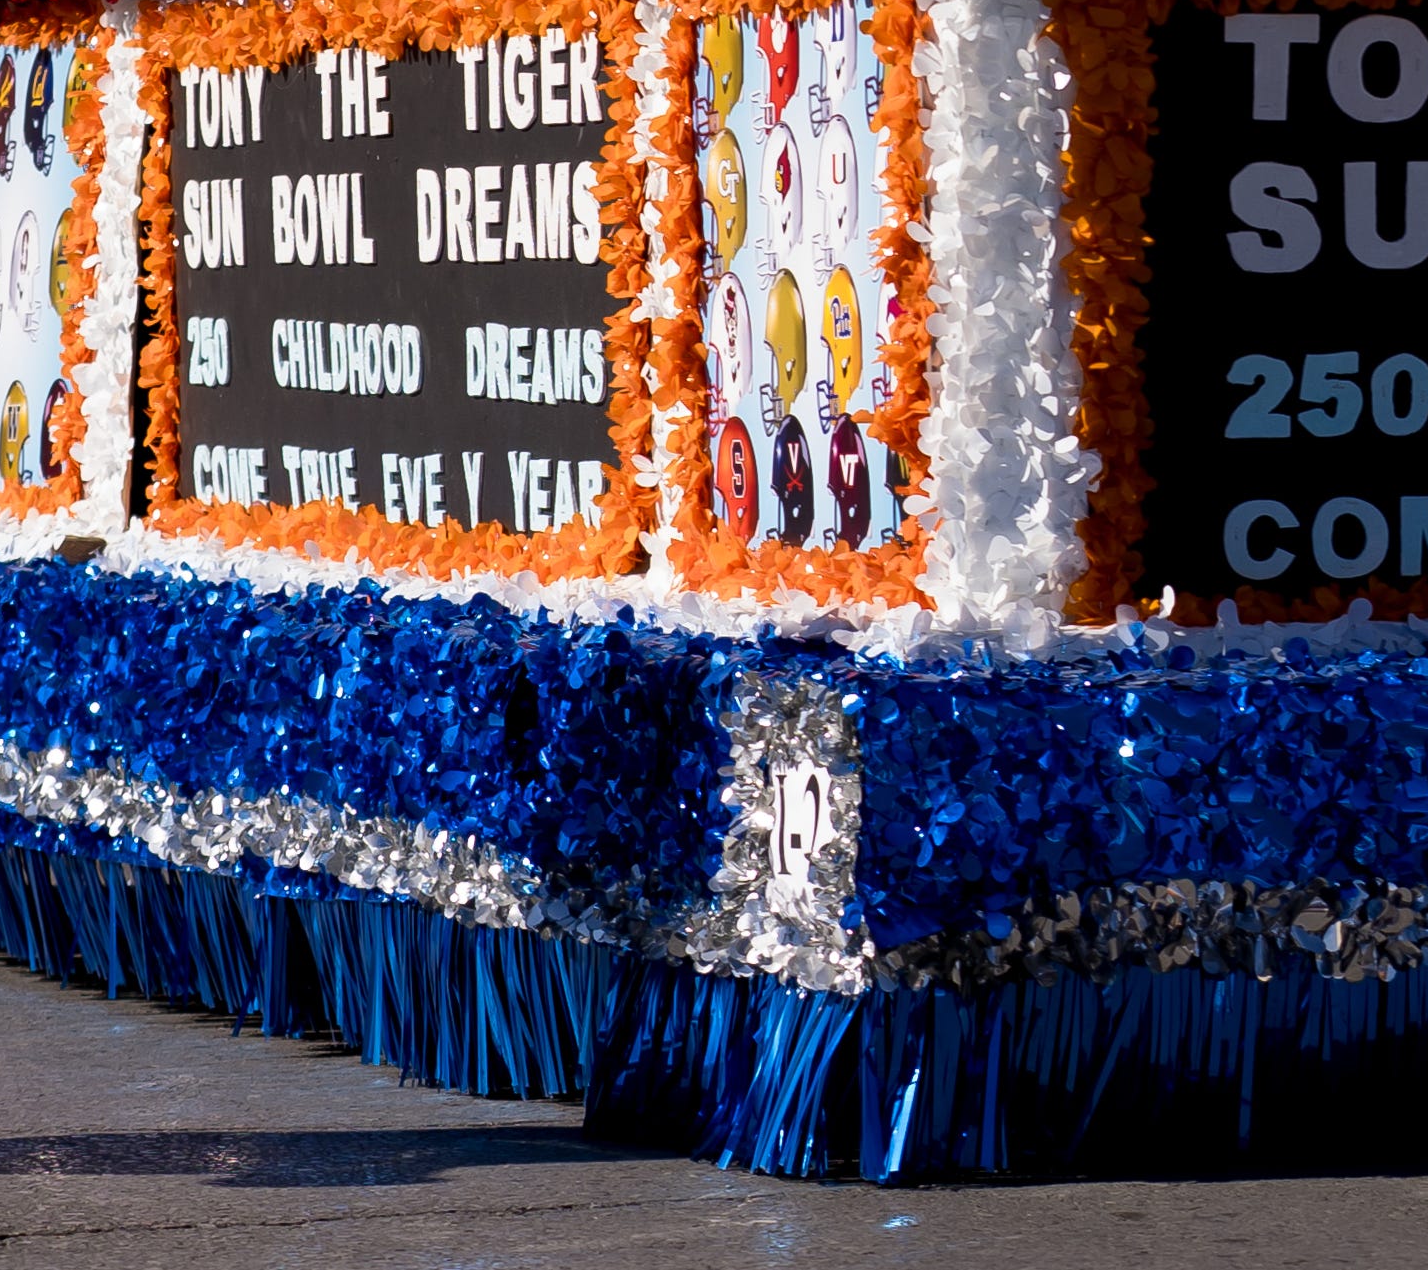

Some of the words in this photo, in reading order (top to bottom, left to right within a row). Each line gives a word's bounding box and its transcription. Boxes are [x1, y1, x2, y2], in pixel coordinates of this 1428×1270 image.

[180, 63, 267, 149] TONY
[315, 46, 392, 141] THE
[457, 27, 603, 131] TIGER
[717, 158, 740, 207] GT
[831, 152, 847, 186] U
[183, 178, 244, 269] SUN
[272, 172, 376, 266] BOWL
[416, 161, 602, 265] DREAMS
[187, 316, 230, 387] 250
[273, 318, 422, 397] CHILDHOOD
[466, 322, 606, 405] DREAMS
[193, 444, 270, 511] COME
[282, 445, 361, 515] TRUE
[508, 451, 606, 534] YEAR
[730, 439, 746, 500] S
[839, 454, 859, 488] VT
